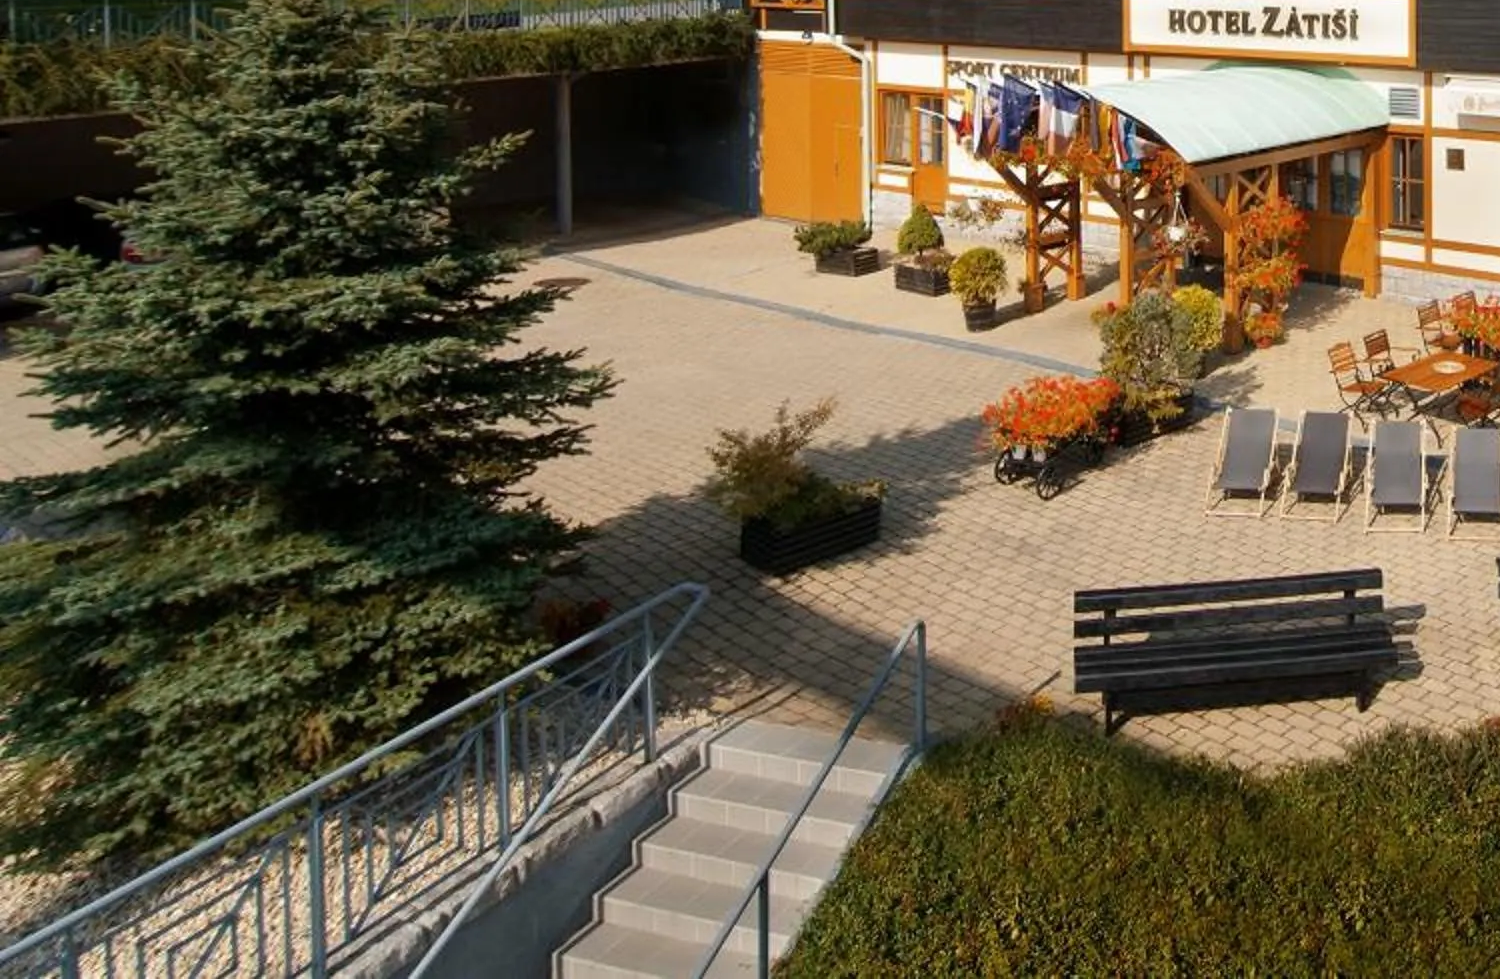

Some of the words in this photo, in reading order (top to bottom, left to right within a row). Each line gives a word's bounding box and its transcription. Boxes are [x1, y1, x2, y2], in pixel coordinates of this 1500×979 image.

[1168, 9, 1257, 36] HOTEL
[946, 61, 994, 78] SPORT
[999, 63, 1081, 84] CENTRUM
